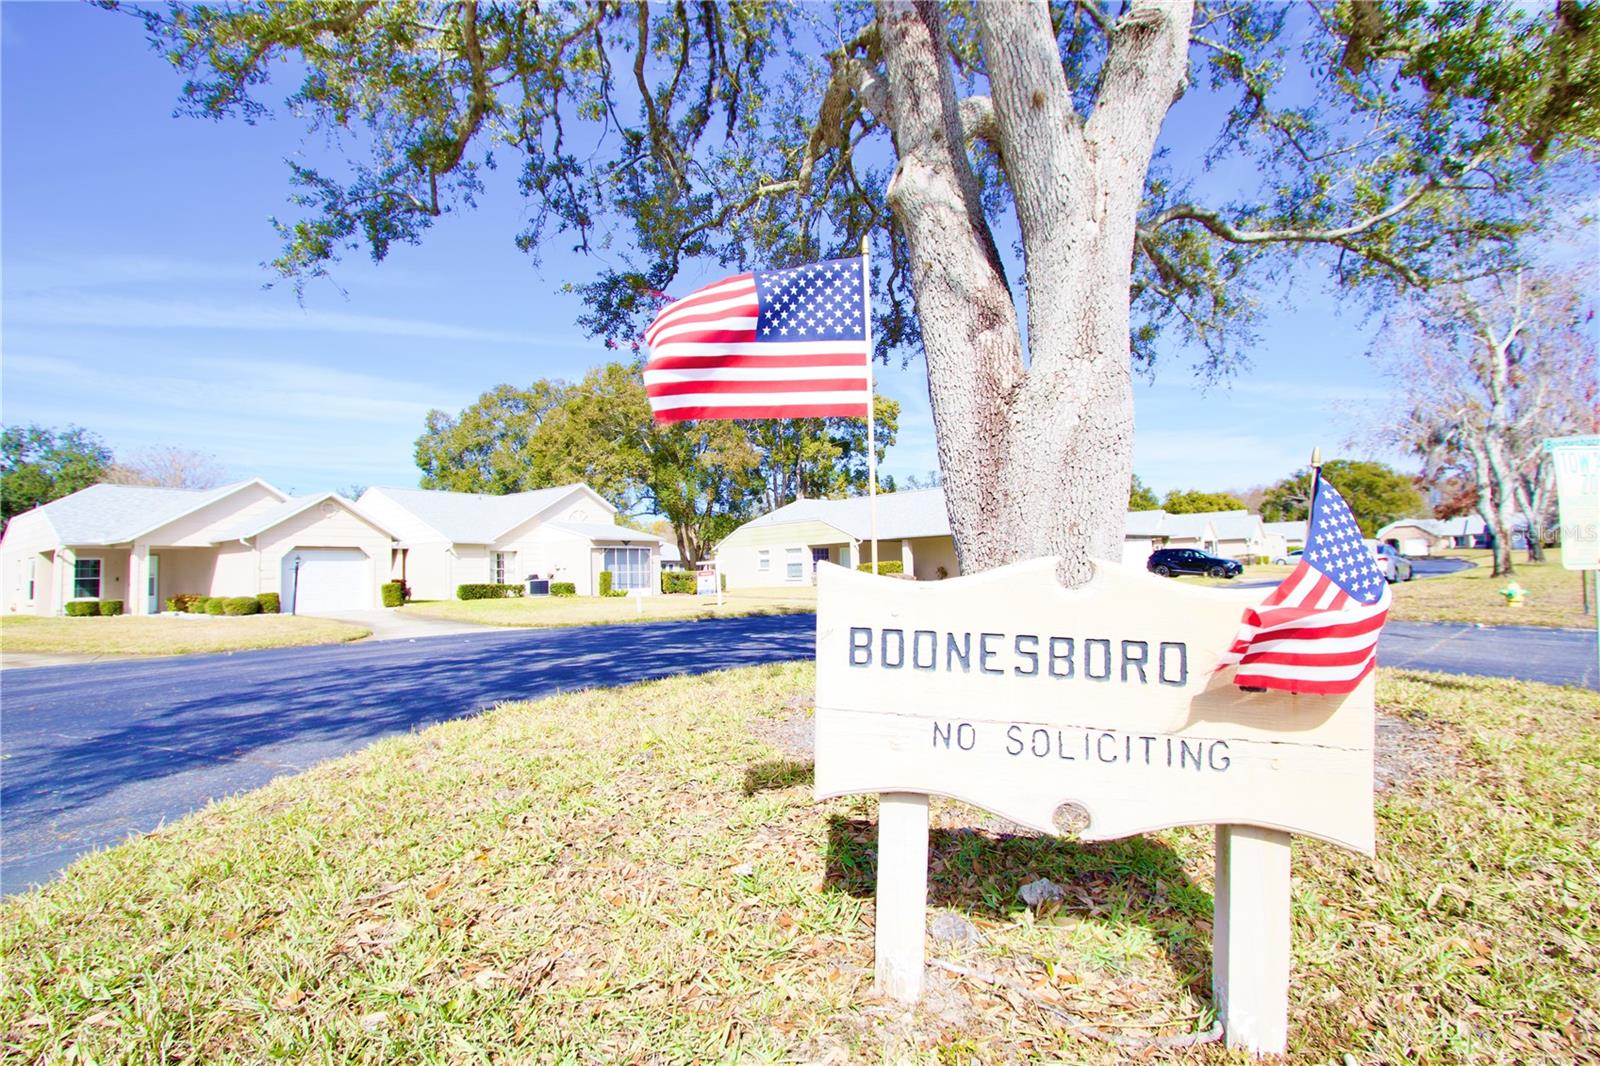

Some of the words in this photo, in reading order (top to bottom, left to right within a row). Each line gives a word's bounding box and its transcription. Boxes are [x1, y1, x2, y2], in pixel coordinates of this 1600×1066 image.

[849, 626, 1189, 687] BOONESBORO
[933, 721, 976, 751] NO
[1006, 725, 1231, 772] SOLICITING
